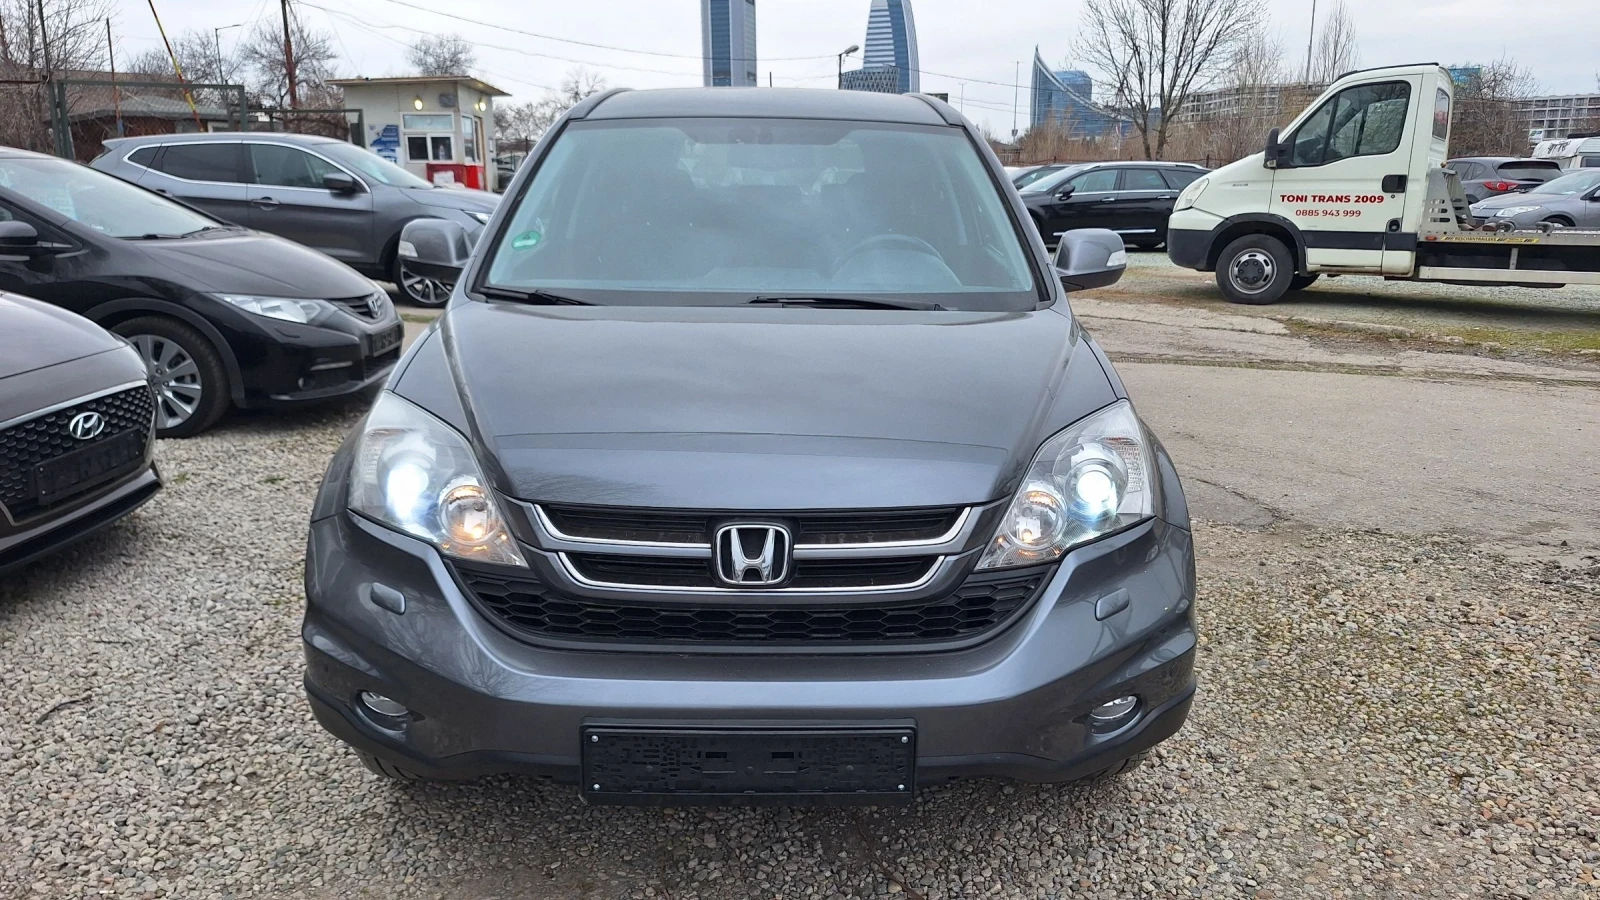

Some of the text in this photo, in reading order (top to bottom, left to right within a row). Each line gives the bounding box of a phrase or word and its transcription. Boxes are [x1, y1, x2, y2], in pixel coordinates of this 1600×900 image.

[1280, 195, 1384, 203] TONI TRANS 2009
[1295, 209, 1319, 217] 0885
[1322, 209, 1340, 217] 943
